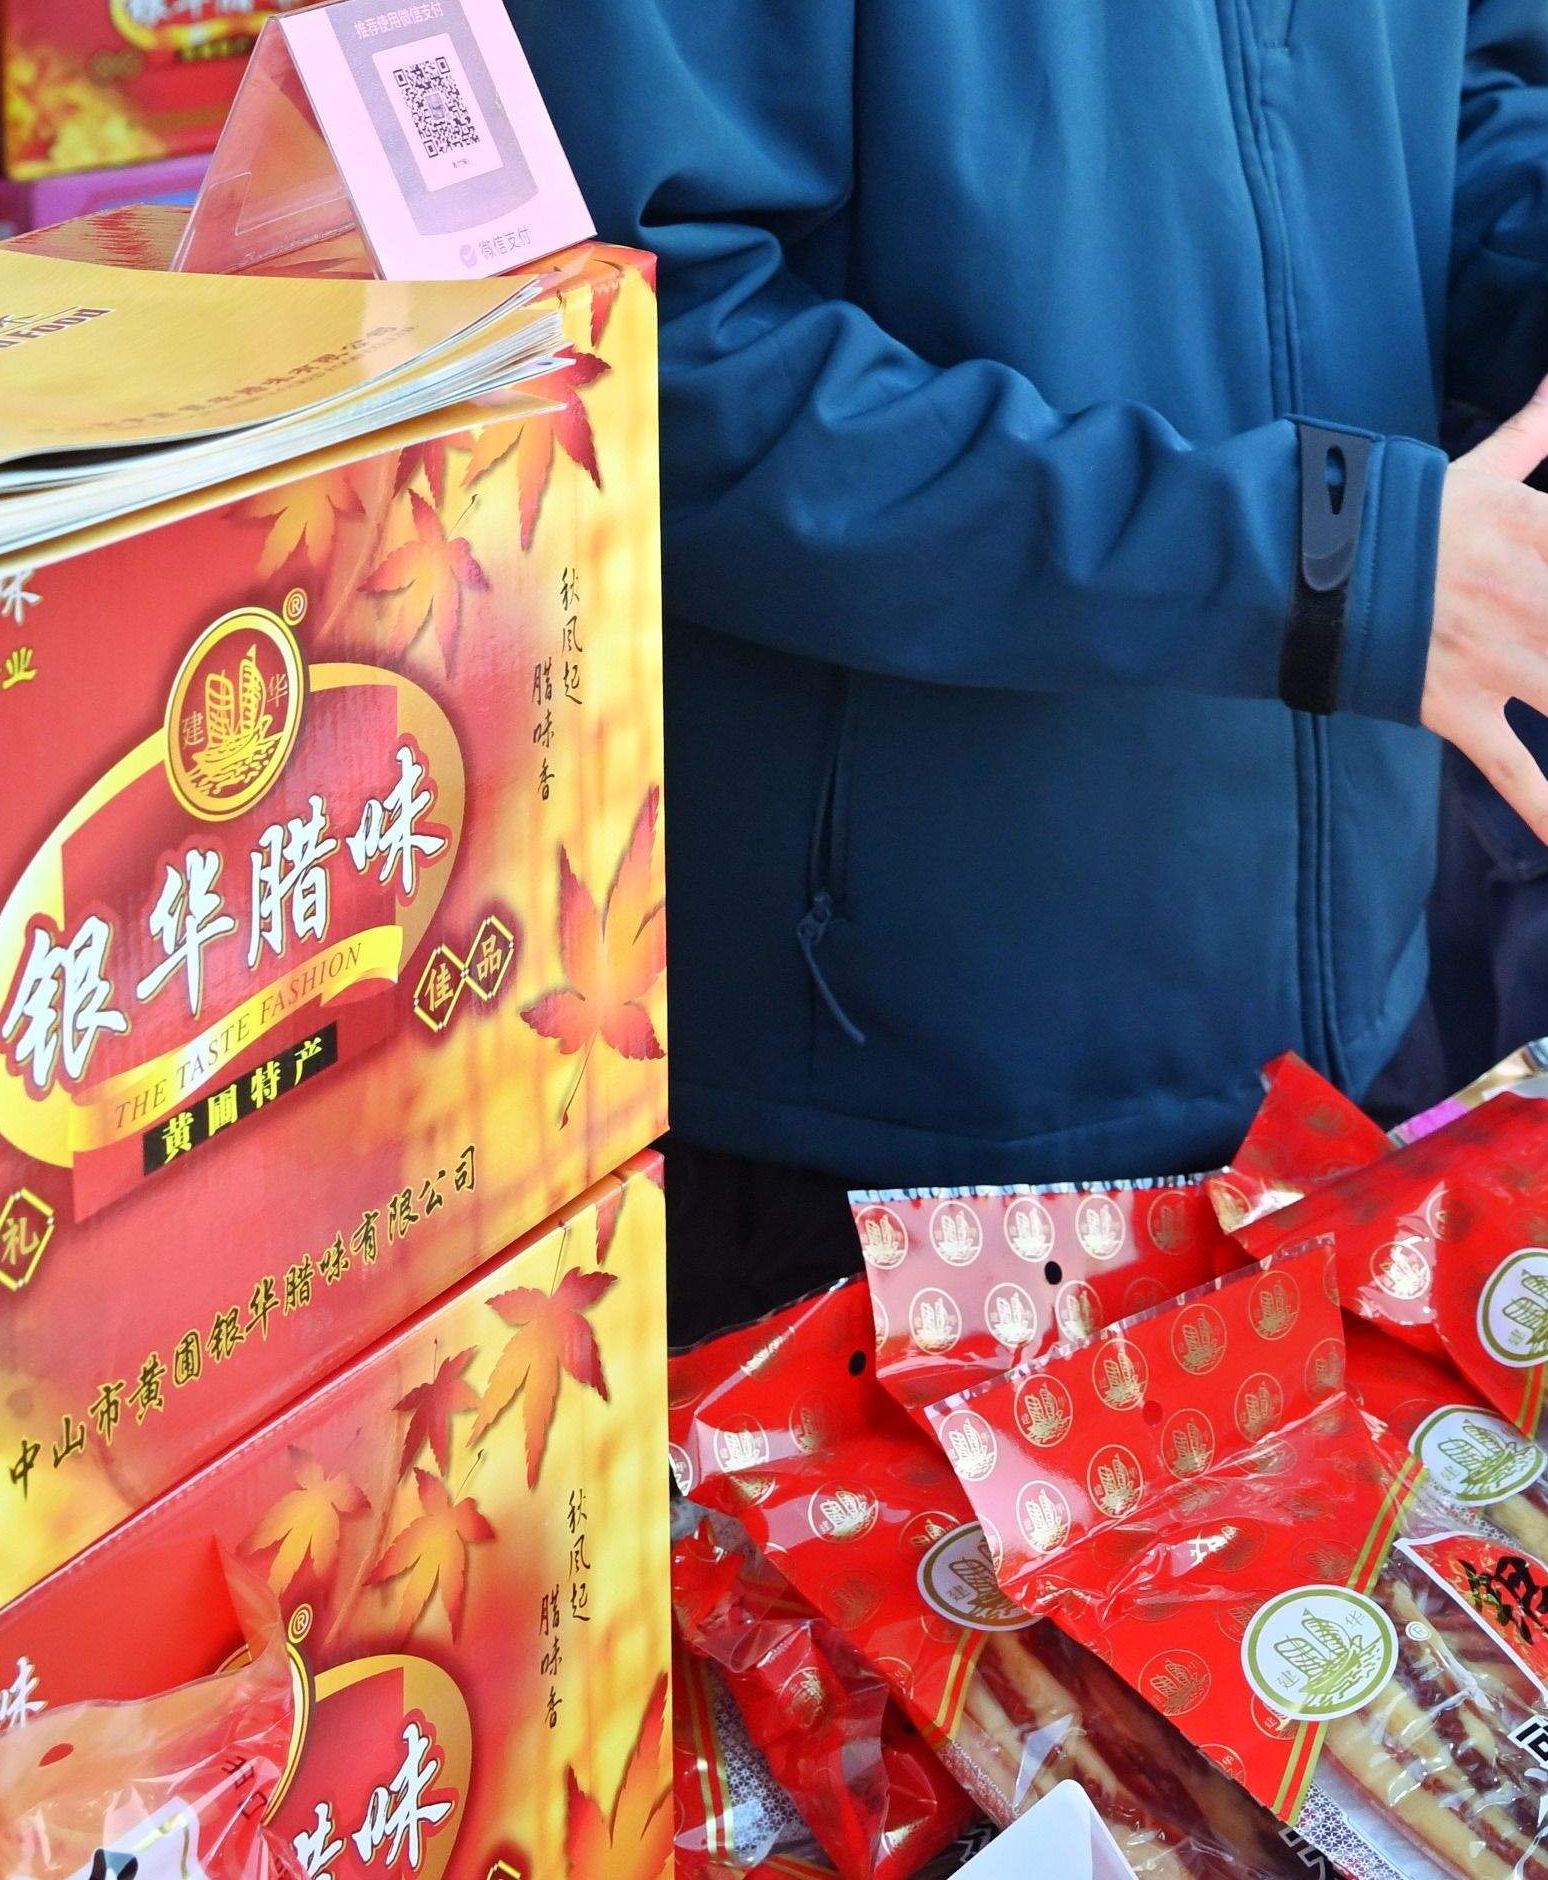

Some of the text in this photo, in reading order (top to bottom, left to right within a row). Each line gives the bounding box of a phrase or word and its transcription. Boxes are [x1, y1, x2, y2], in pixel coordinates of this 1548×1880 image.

[354, 1, 444, 39] 推荐使用微信支付
[478, 225, 532, 258] 微信支付
[11, 306, 115, 344] Food
[265, 672, 290, 712] 华
[560, 566, 584, 708] 秋风起
[530, 660, 556, 804] 腊味香
[1, 747, 449, 1090] 银华腊味
[427, 933, 506, 1008] 佳品
[114, 939, 363, 1131] THE TASTE FASHION
[161, 1035, 327, 1164] 黄圃特产
[7, 1145, 482, 1501] 中山市黄圃银华腊味有限公司
[566, 1487, 593, 1625] 秋风起
[538, 1583, 563, 1732] 腊味香
